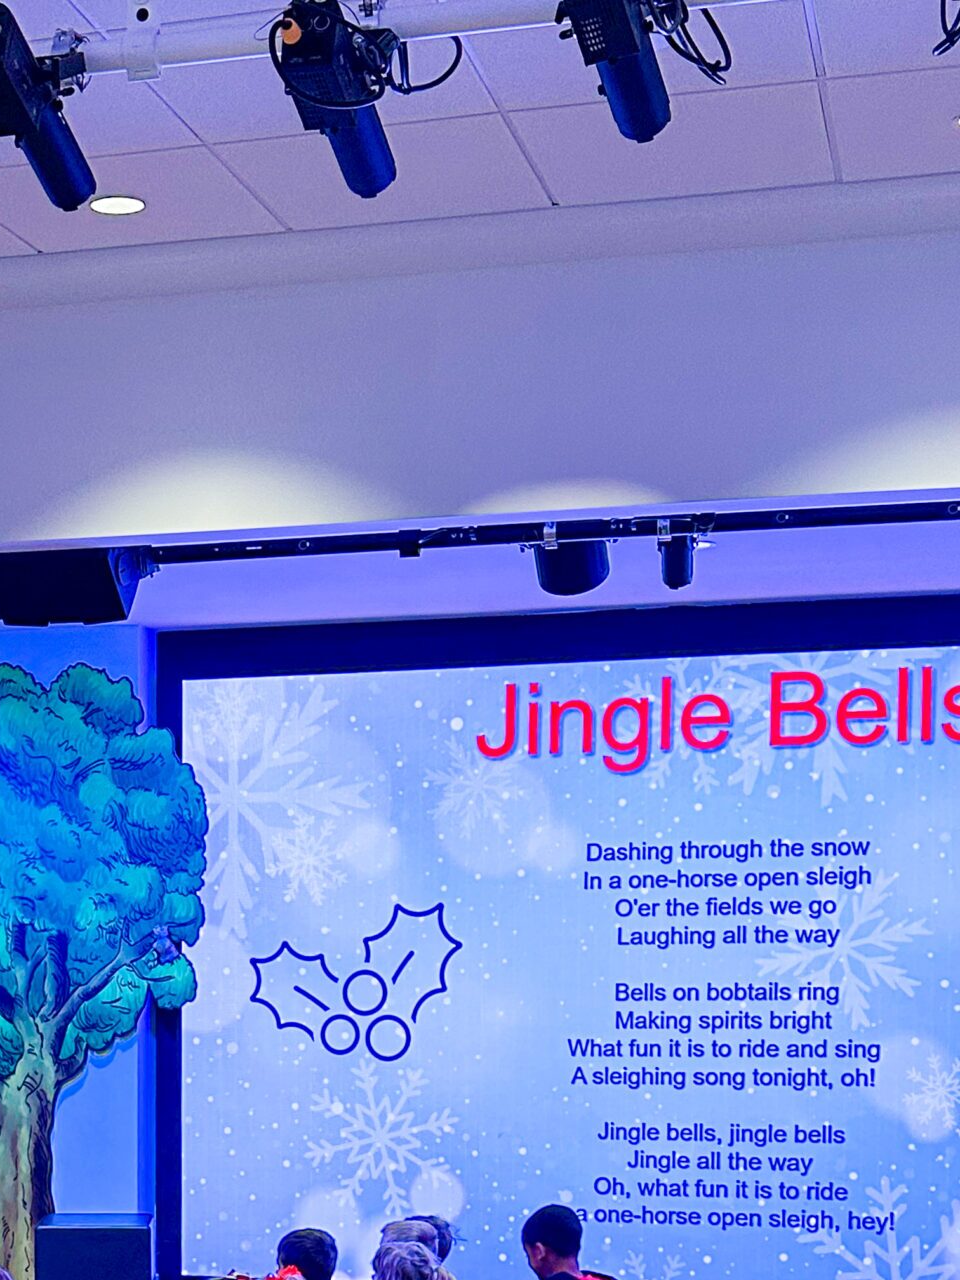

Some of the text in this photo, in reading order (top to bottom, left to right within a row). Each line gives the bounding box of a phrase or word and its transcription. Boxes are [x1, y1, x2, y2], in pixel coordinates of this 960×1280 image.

[476, 676, 733, 773] Jingle
[587, 839, 870, 864] Dashing through the snow
[584, 866, 871, 890] In a one-horse open sleigh
[616, 897, 836, 919] O'er the fields we go
[618, 925, 840, 949] Laughing all the way
[616, 982, 839, 1005] Bells on bobtails ring
[616, 1011, 832, 1034] Making spirits bright
[568, 1039, 880, 1062] What fun it is to ride and sing
[571, 1067, 874, 1090] A sleighing song tonight, oh!
[598, 1122, 845, 1147] Jingle bells, jingle bells
[628, 1150, 813, 1176] Jingle all the way
[594, 1177, 848, 1200] Oh, what fun it is to ride
[594, 1206, 701, 1225] one-horse
[708, 1212, 761, 1230] open
[769, 1209, 839, 1233] sleigh,
[848, 1211, 894, 1232] hey!
